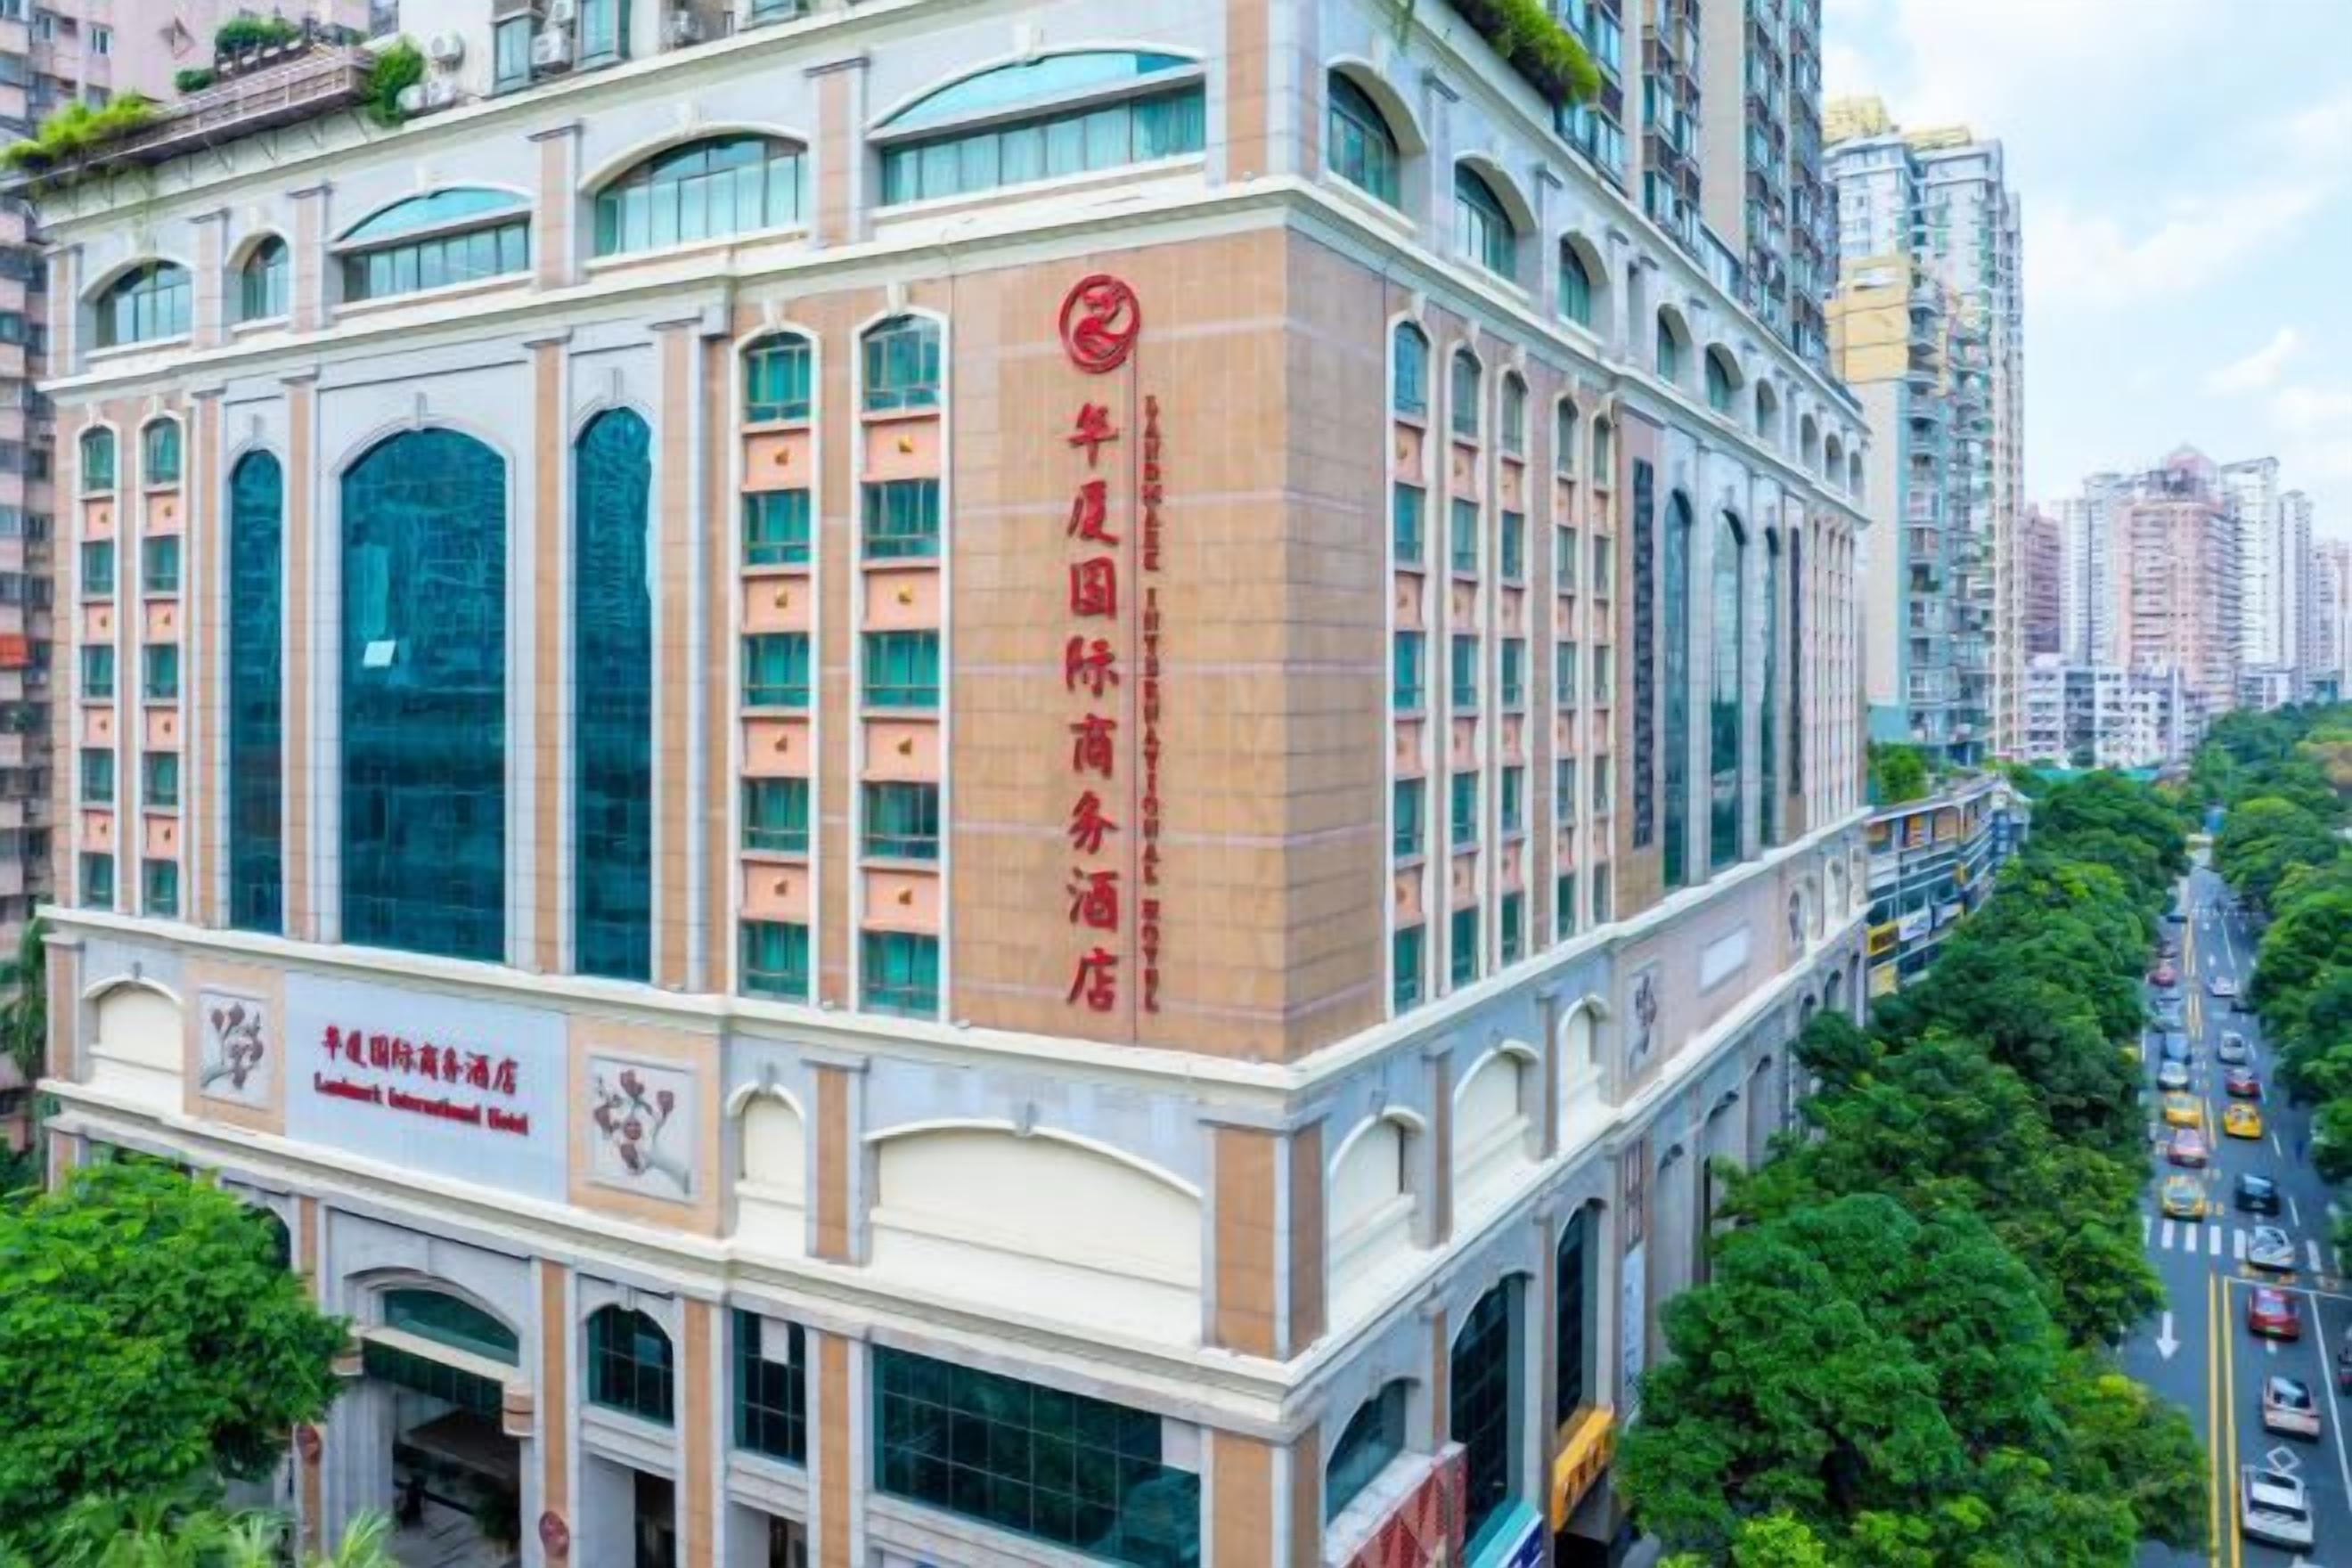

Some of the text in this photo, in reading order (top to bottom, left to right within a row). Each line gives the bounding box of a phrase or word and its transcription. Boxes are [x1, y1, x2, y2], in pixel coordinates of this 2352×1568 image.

[1066, 402, 1120, 1012] 华厦国际商务酒店
